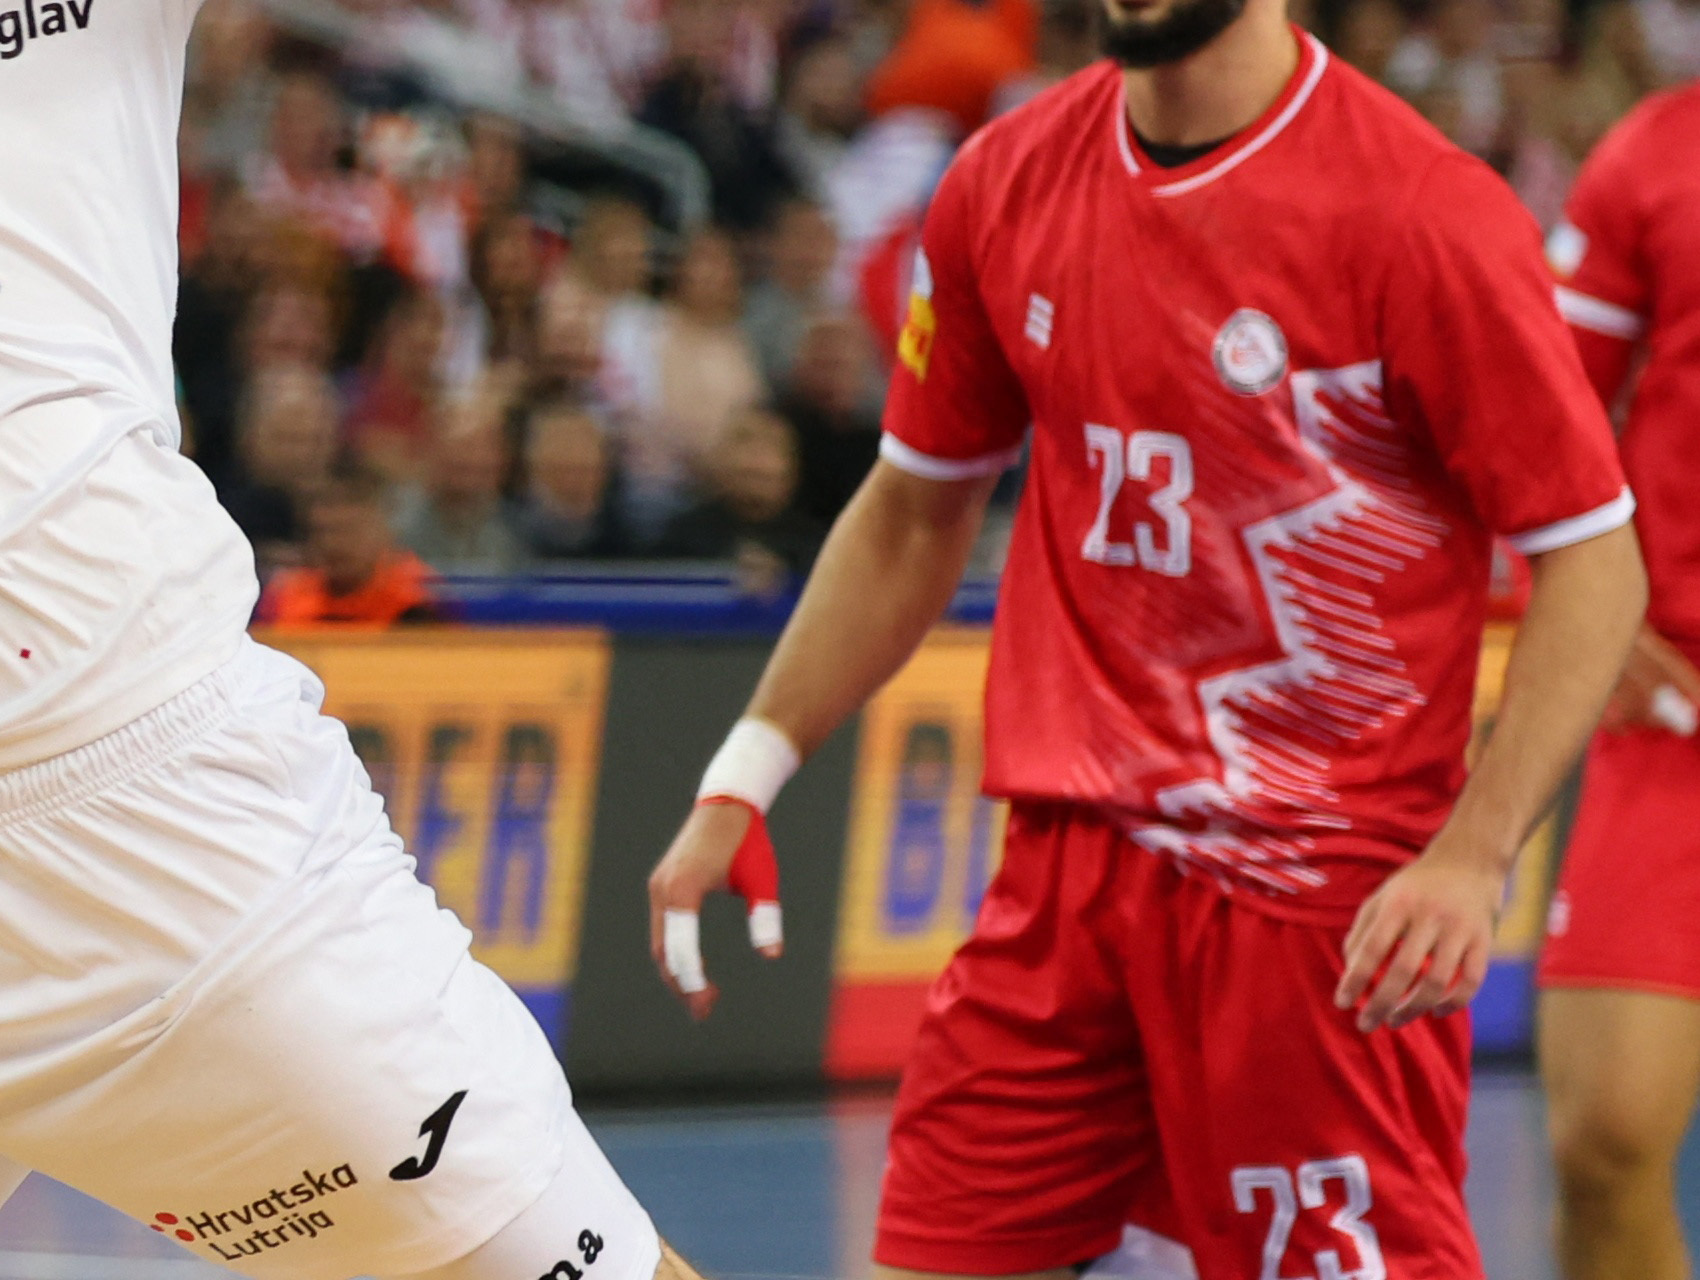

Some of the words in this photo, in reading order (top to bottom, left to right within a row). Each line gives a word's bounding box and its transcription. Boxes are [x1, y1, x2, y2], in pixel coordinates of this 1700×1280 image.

[1080, 421, 1196, 579] 23
[185, 1162, 360, 1241] Hrvatska
[207, 1208, 336, 1263] Lutrija
